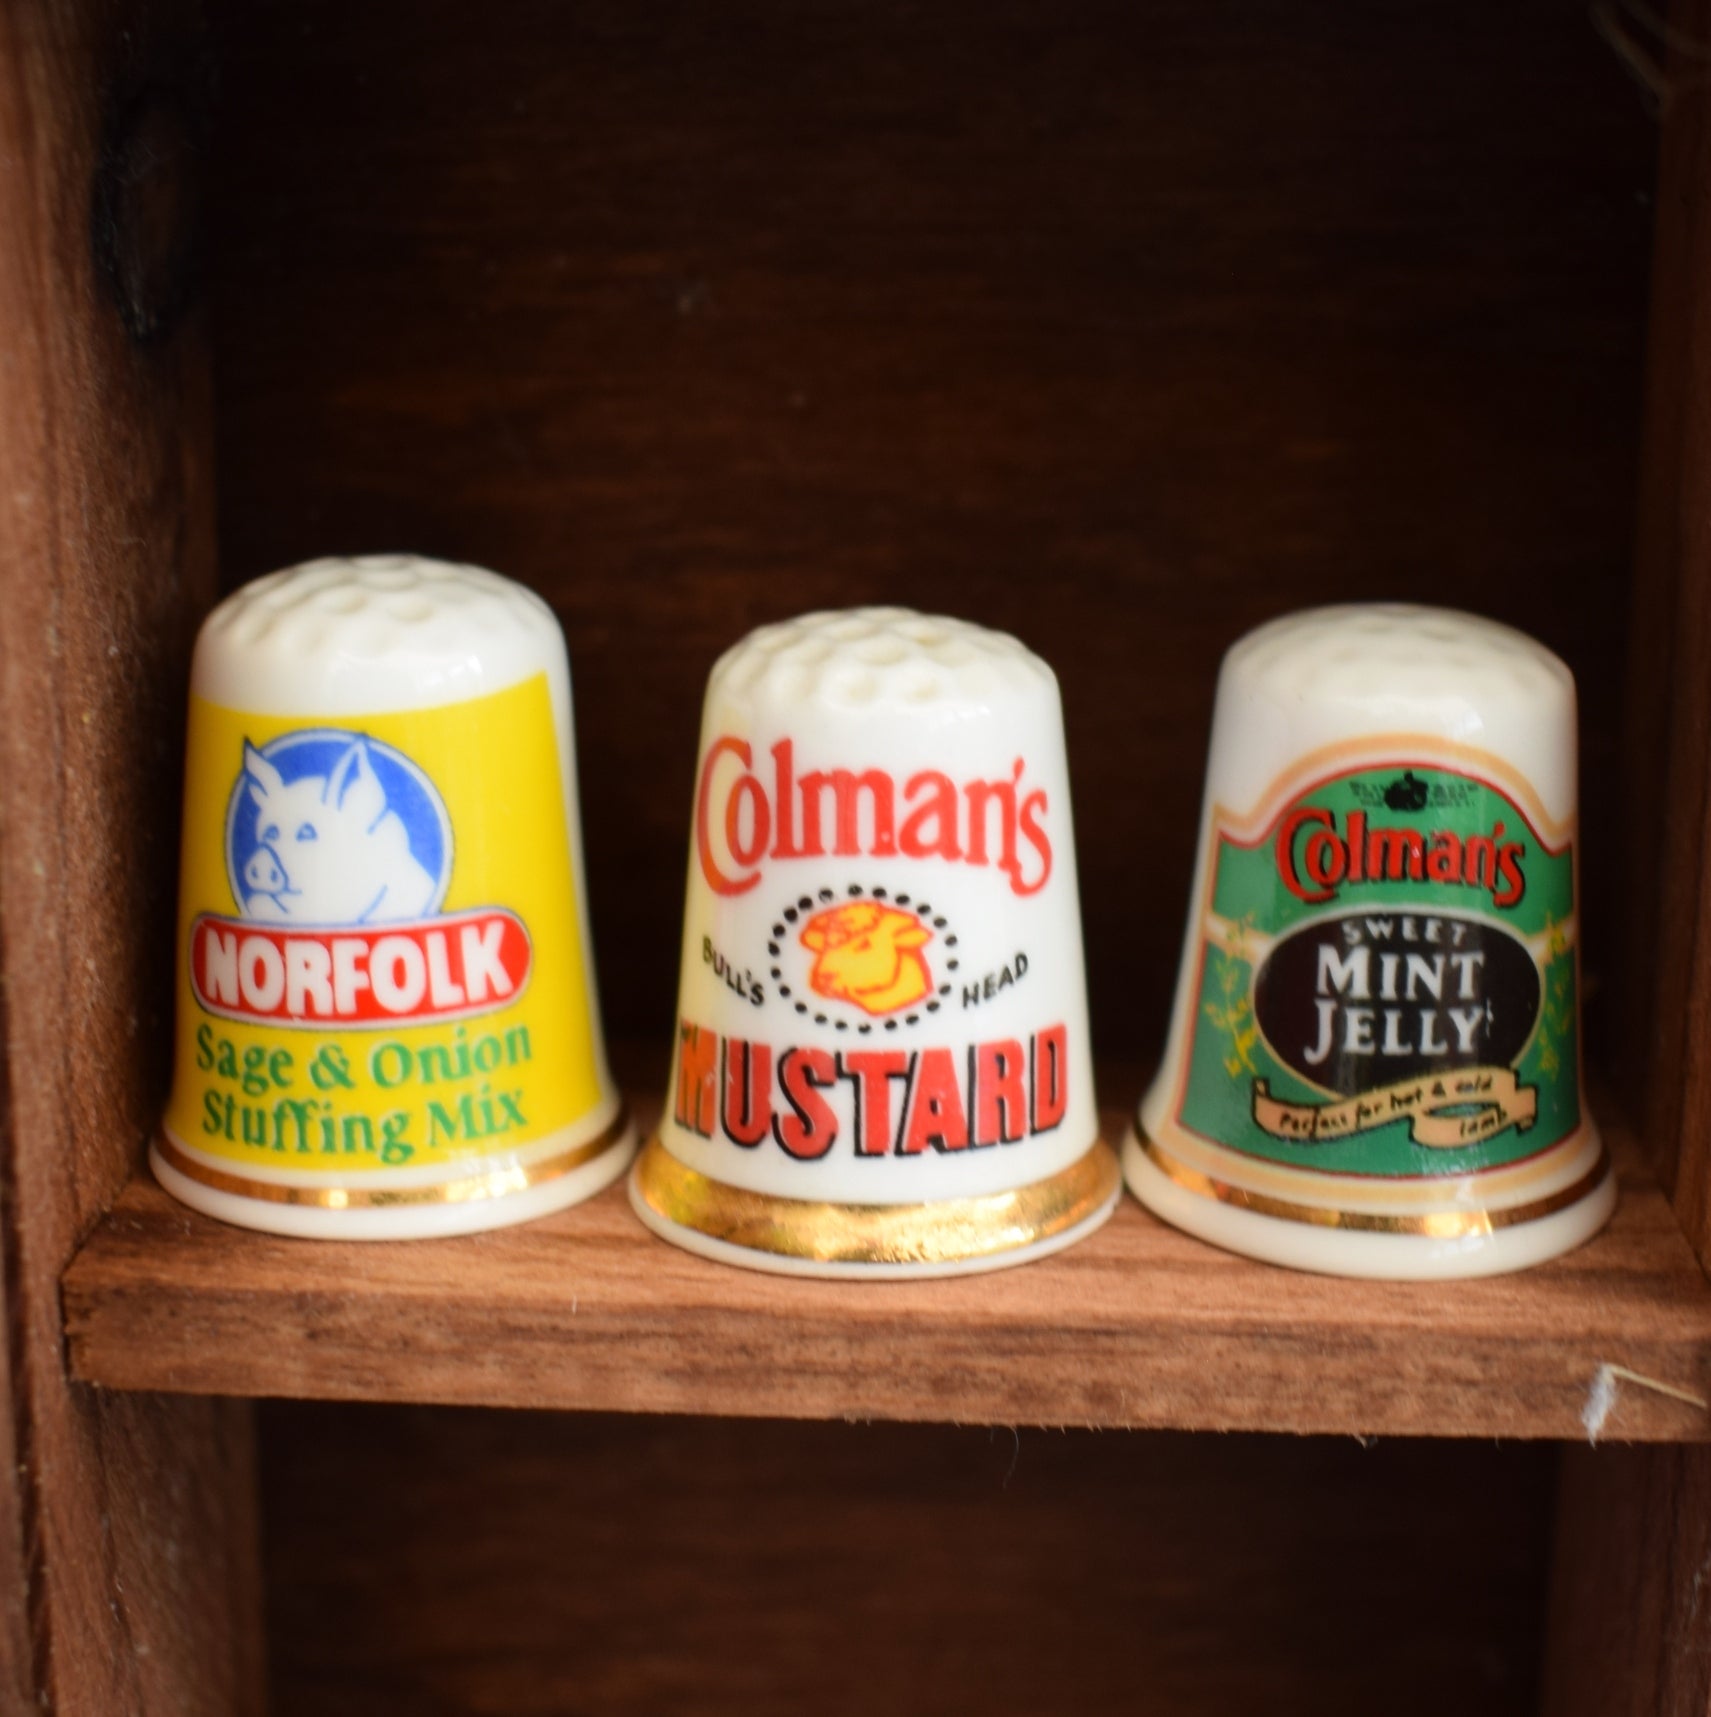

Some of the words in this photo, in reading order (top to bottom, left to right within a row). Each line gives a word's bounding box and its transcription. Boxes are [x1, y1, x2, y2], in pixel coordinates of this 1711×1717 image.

[698, 735, 1053, 897] Colman's
[1276, 807, 1525, 906] Colman's
[204, 920, 514, 1016] NORFOLK
[1341, 916, 1468, 945] SWEET
[702, 937, 765, 1008] BULL'S
[961, 952, 1030, 1010] HEAD
[1316, 944, 1485, 1001] MINT
[197, 1023, 294, 1096] Sage
[309, 1043, 355, 1090] &
[370, 1025, 532, 1088] Onion
[1303, 999, 1486, 1065] JELLY
[202, 1089, 415, 1165] Stuffing
[427, 1084, 529, 1147] Mix
[674, 1021, 1068, 1161] MUSTARD
